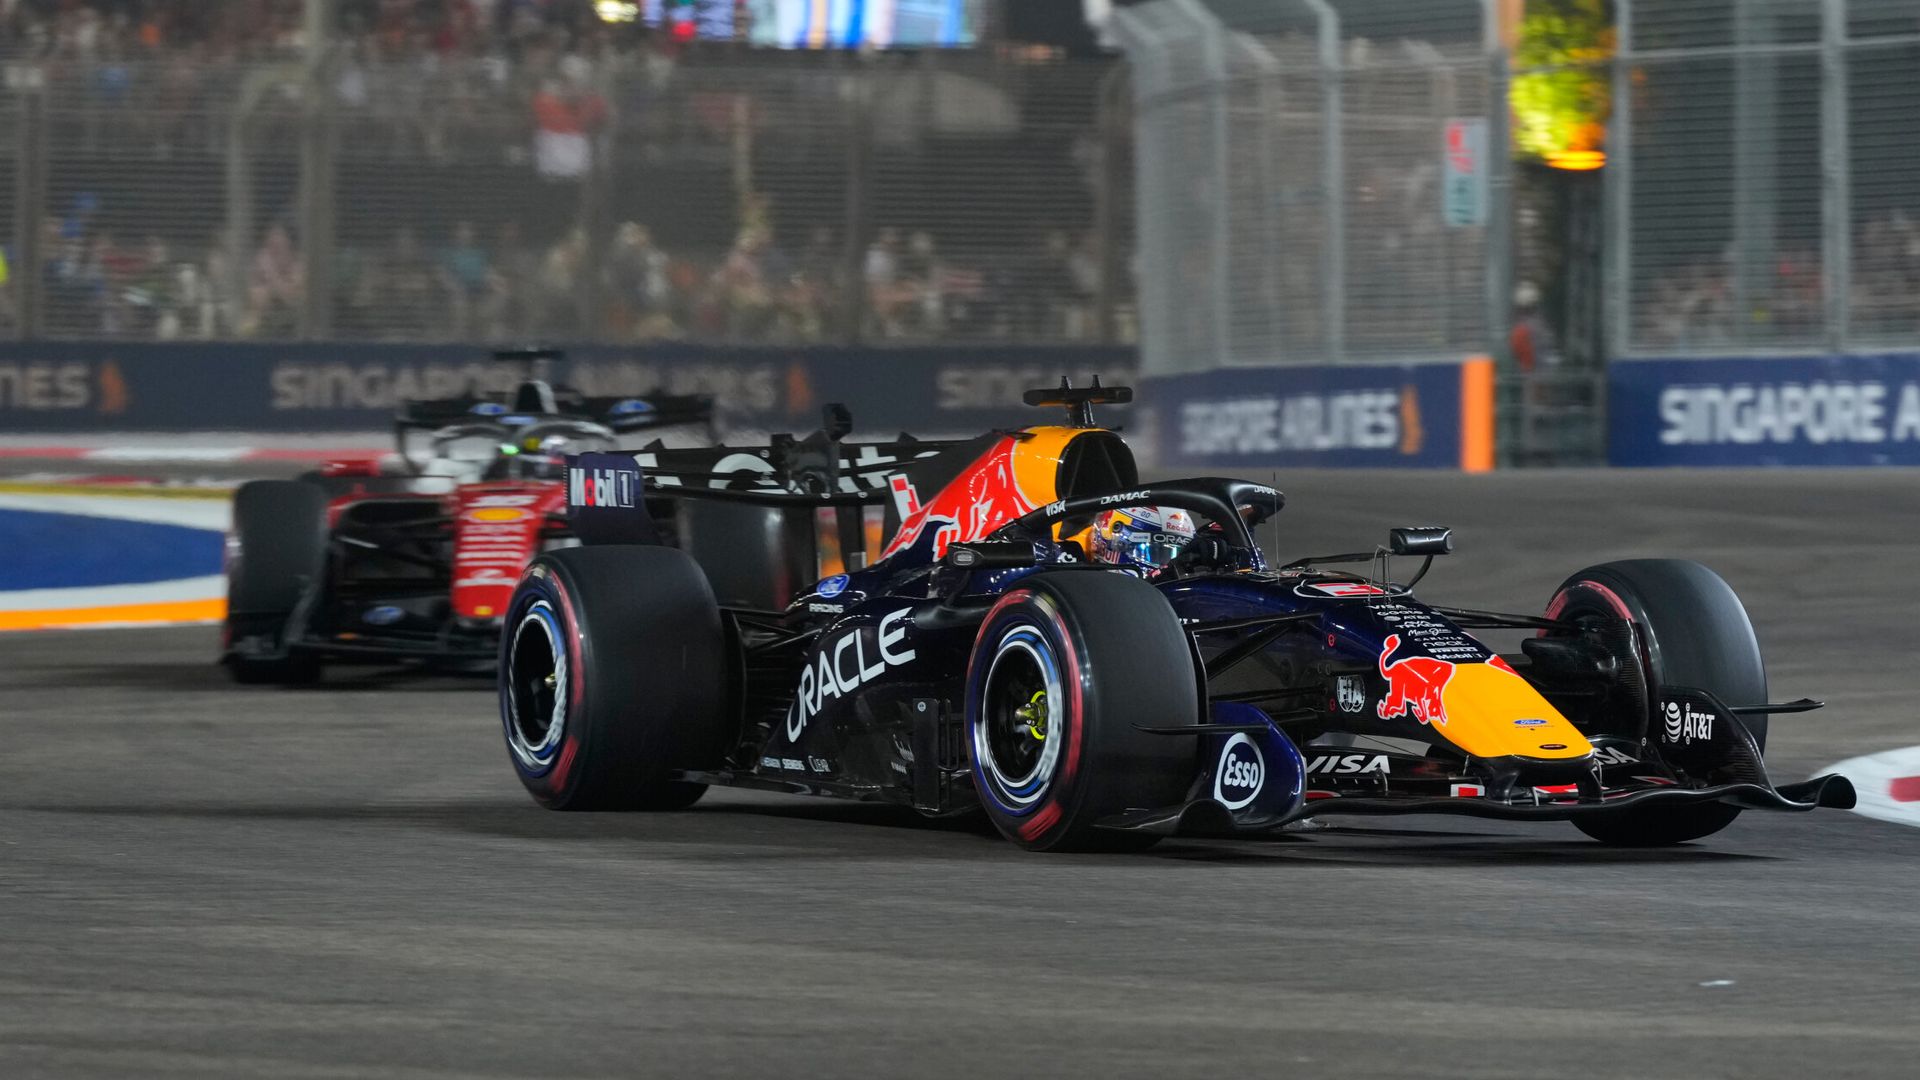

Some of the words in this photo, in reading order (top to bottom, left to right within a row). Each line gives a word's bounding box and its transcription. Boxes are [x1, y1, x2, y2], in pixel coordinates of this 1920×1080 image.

[1660, 383, 1887, 443] SINGAPORE
[570, 468, 618, 507] Mobil
[618, 472, 631, 505] 1
[1100, 489, 1151, 505] DAMAC
[1045, 499, 1067, 517] VISA
[786, 606, 916, 744] ORACLE
[1683, 711, 1715, 740] AT&T
[1223, 752, 1259, 789] Esso
[1304, 755, 1391, 774] VISA
